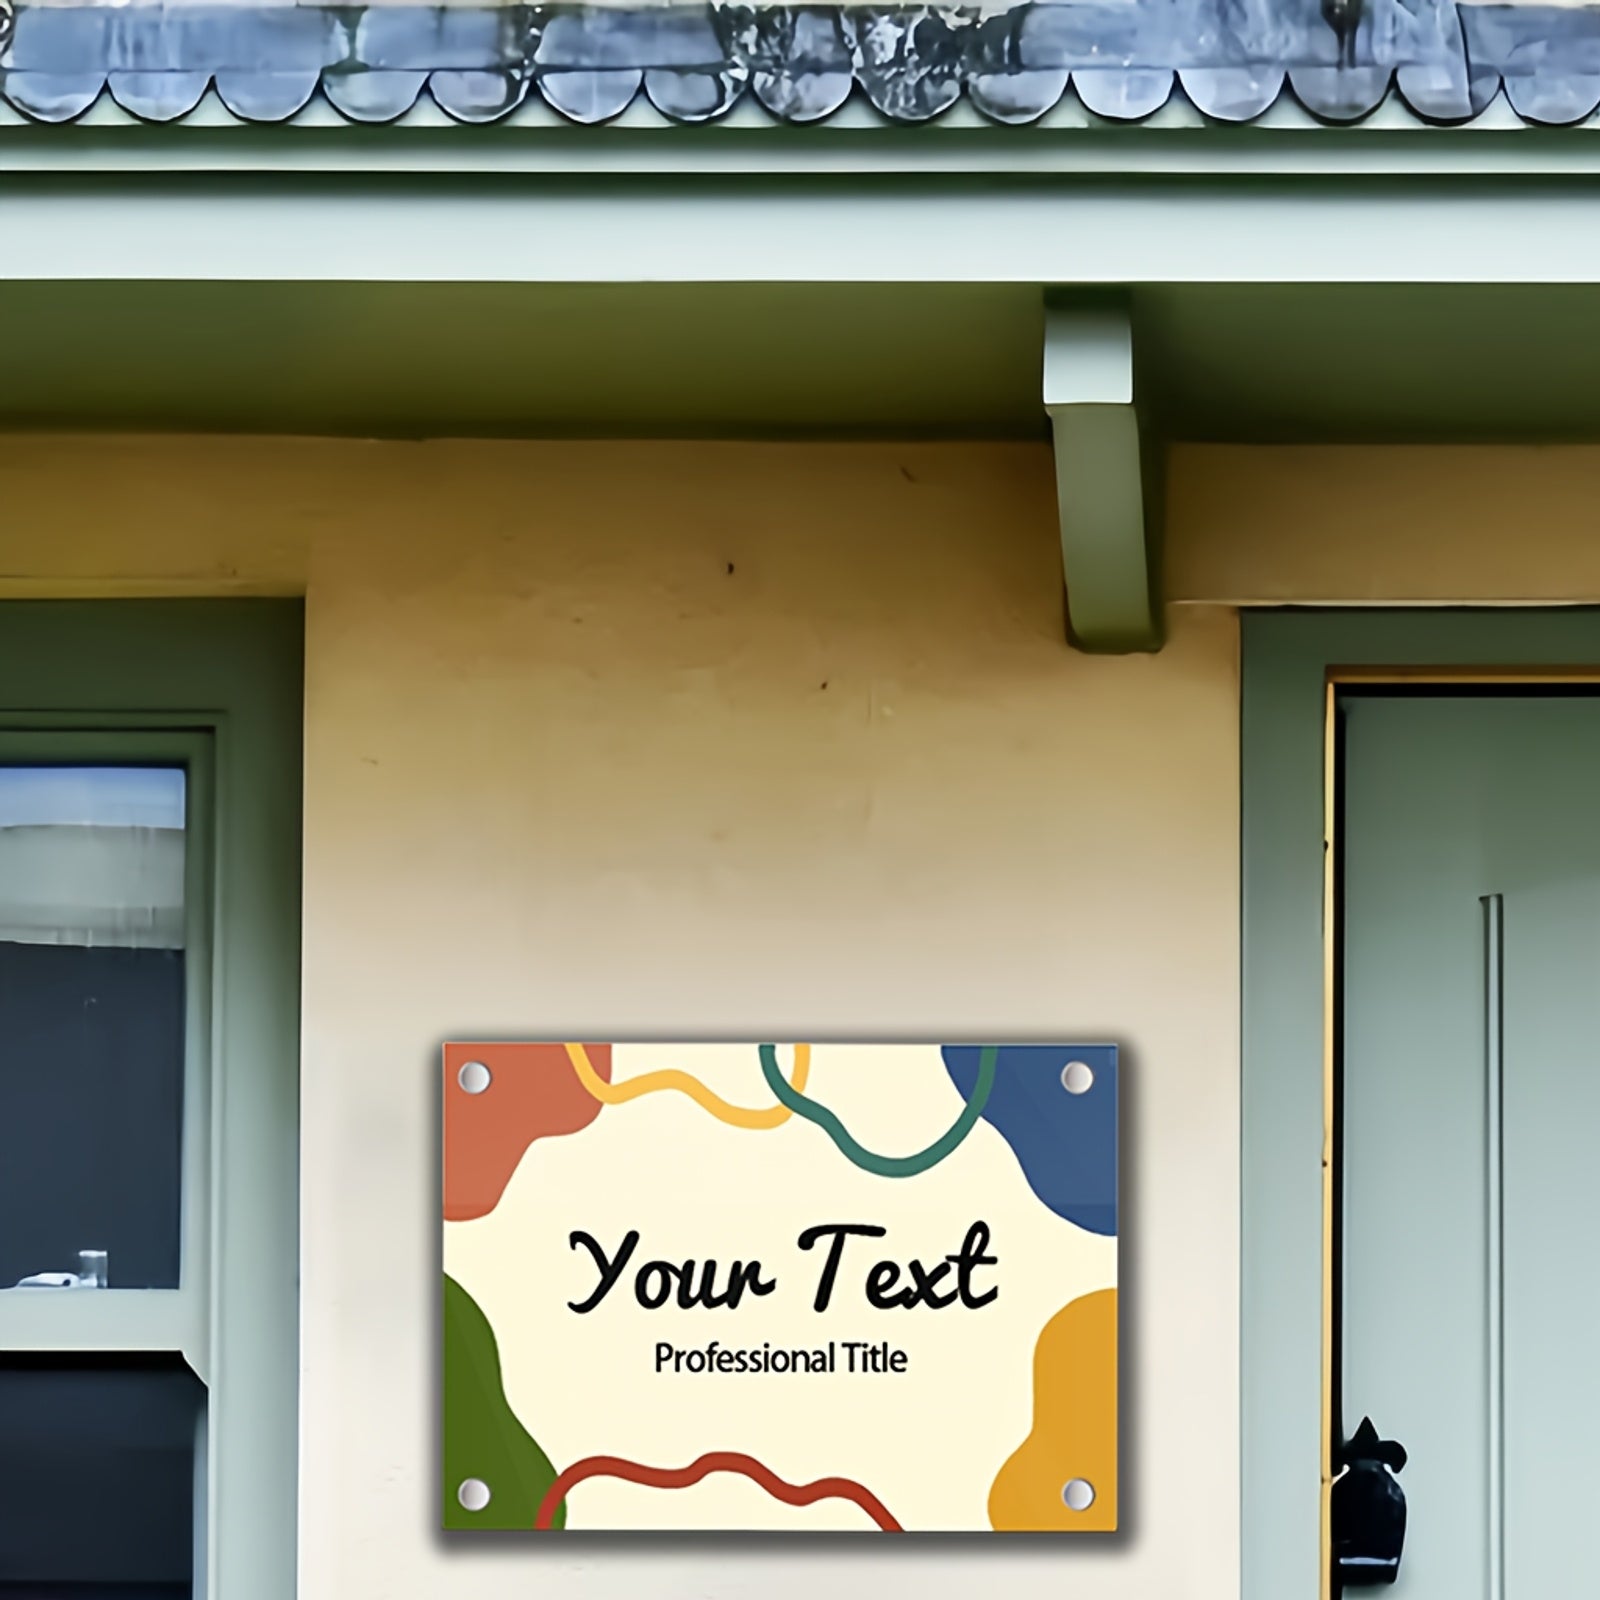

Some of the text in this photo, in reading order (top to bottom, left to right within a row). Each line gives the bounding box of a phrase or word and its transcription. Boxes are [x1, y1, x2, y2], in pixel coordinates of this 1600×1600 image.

[567, 1220, 999, 1314] Your Text
[655, 1341, 908, 1373] Professional Title
